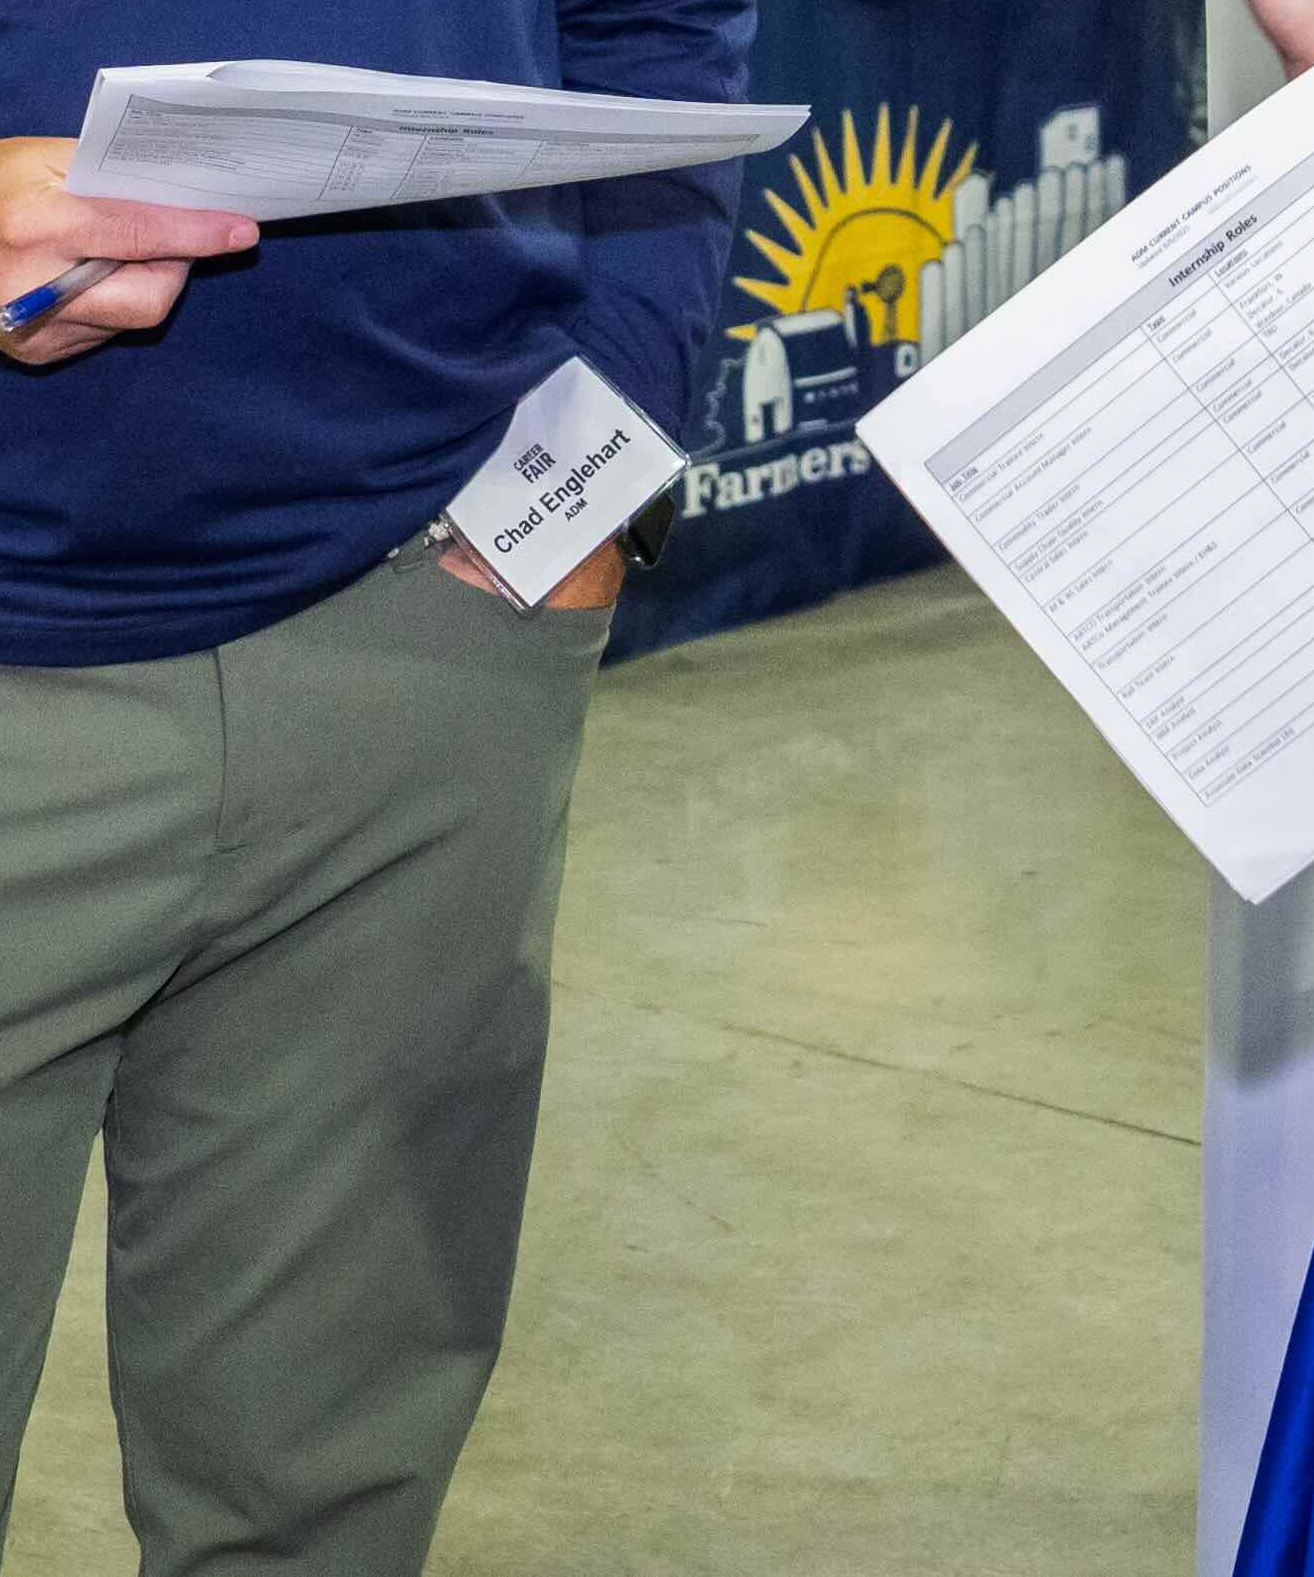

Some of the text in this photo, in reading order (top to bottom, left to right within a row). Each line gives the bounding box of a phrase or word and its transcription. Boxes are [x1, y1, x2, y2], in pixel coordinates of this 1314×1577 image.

[1167, 238, 1227, 289] Internship
[1224, 211, 1260, 242] Roles
[513, 443, 543, 471] CAREER
[521, 452, 556, 484] FAIR
[682, 438, 872, 518] Farmers
[493, 428, 631, 554] Chad Englehart
[564, 497, 589, 522] ADM
